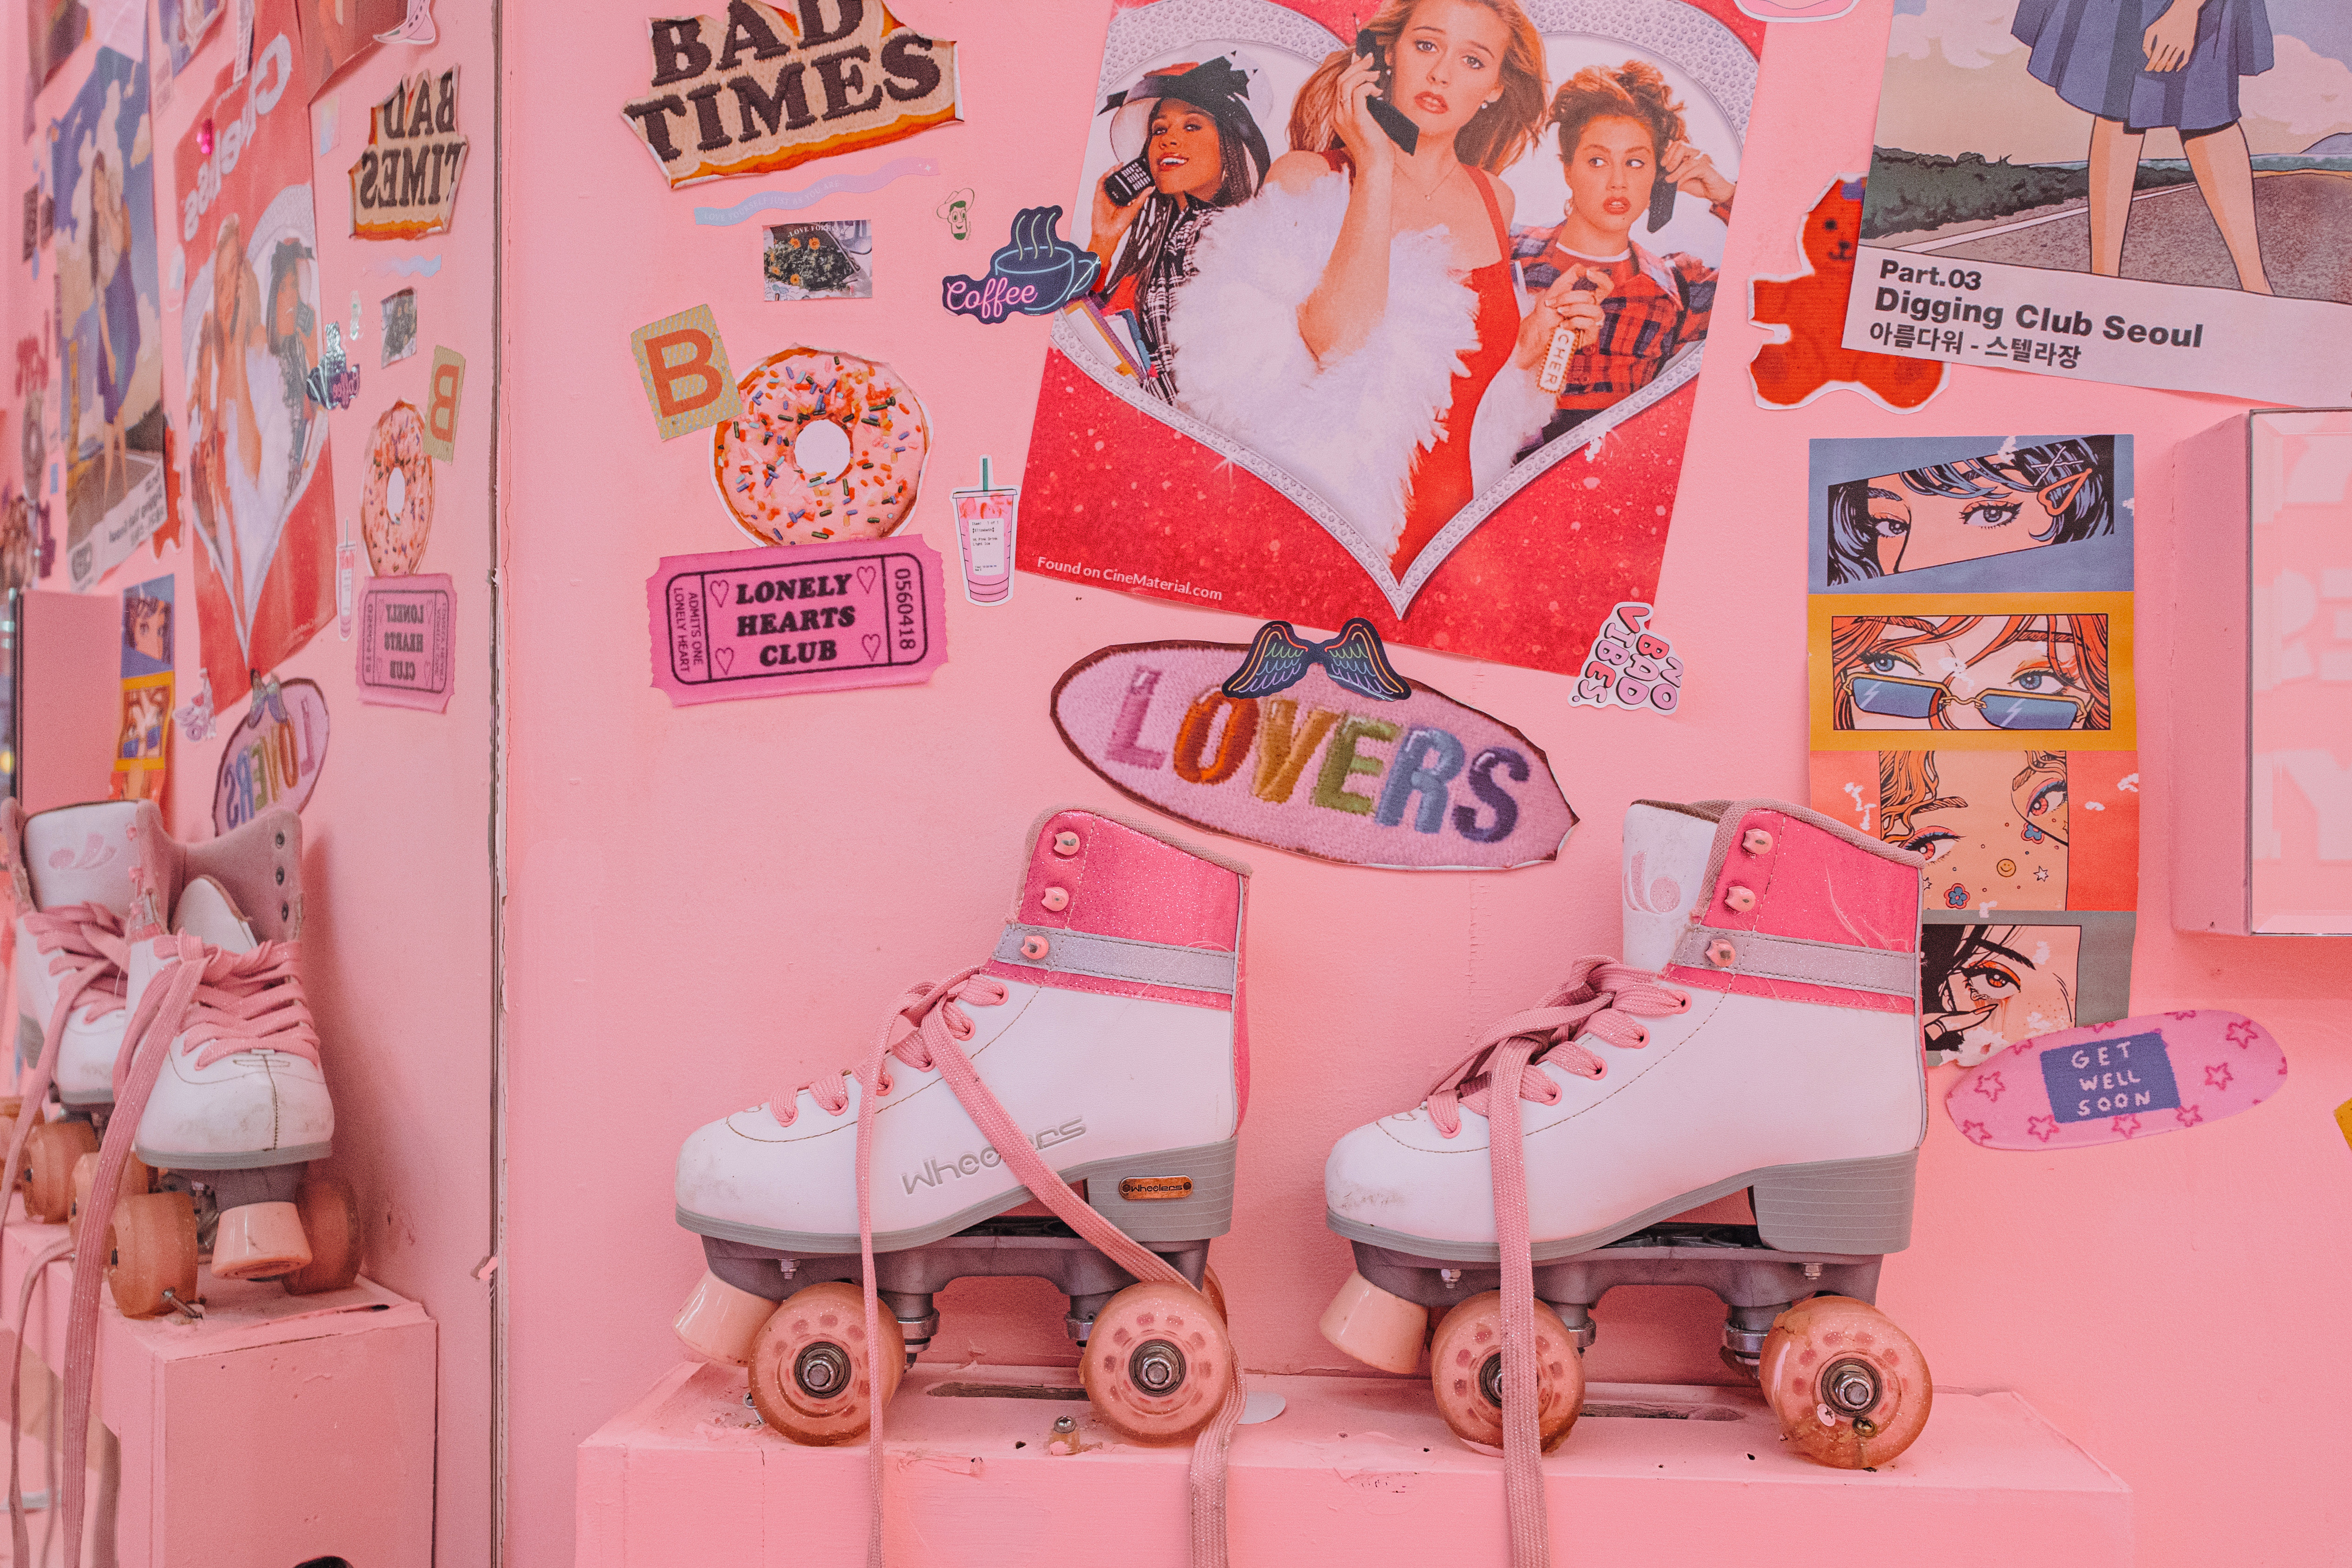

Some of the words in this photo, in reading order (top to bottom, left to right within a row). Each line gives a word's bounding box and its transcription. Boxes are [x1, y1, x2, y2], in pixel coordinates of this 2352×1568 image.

[652, 0, 863, 87] BAD
[624, 34, 941, 162] TIMES
[805, 188, 821, 201] YOU
[1879, 258, 1982, 290] Part.03
[946, 277, 1038, 319] Coffee
[1874, 286, 2004, 330] Digging
[2016, 304, 2092, 336] Club
[2102, 314, 2204, 348] Seoul
[1544, 334, 1569, 384] CHER
[1869, 321, 1964, 355] 아름다워
[1984, 335, 2082, 369] 스텔라장
[645, 328, 723, 419] B
[736, 573, 853, 605] LONELY
[1037, 556, 1081, 575] Found
[1083, 567, 1100, 579] on
[1103, 569, 1223, 601] CineMaterial.com
[673, 587, 687, 632] LONELY
[689, 593, 701, 639] ADMITS
[737, 605, 855, 637] HEARTS
[895, 568, 916, 650] 0560418
[678, 633, 690, 672] HEART
[692, 640, 704, 665] ONE
[759, 639, 837, 666] CLUB
[1616, 633, 1670, 705] BAD
[1650, 656, 1684, 711] NO
[1105, 665, 1531, 843] LOVERS
[2071, 1041, 2132, 1069] GET
[2077, 1090, 2151, 1117] SOON
[2079, 1070, 2141, 1092] WELL
